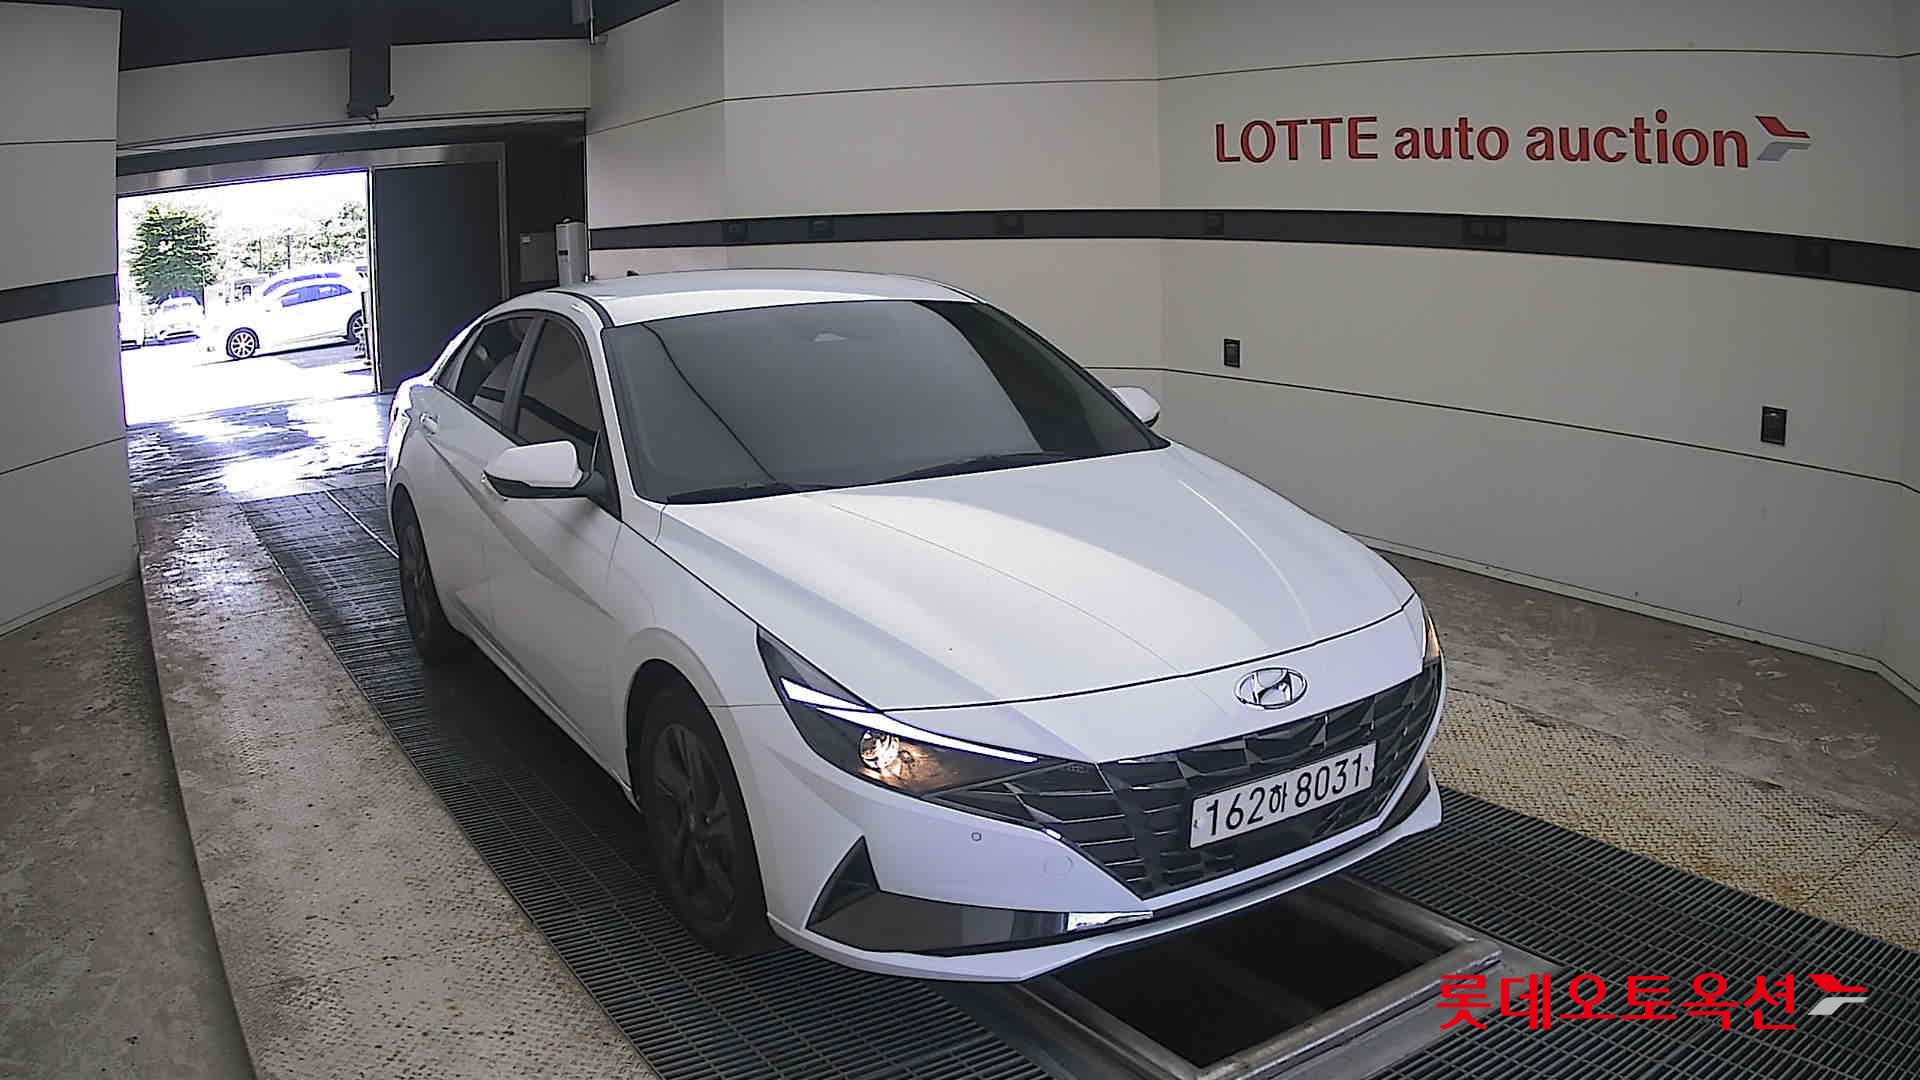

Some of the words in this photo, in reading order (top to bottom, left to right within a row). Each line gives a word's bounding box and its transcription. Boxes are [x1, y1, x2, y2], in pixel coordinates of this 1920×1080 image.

[1215, 116, 1379, 163] LOTTE
[1393, 116, 1510, 162] auto
[1525, 108, 1749, 168] auction
[1206, 781, 1288, 836] 162하
[1294, 752, 1363, 808] 8031
